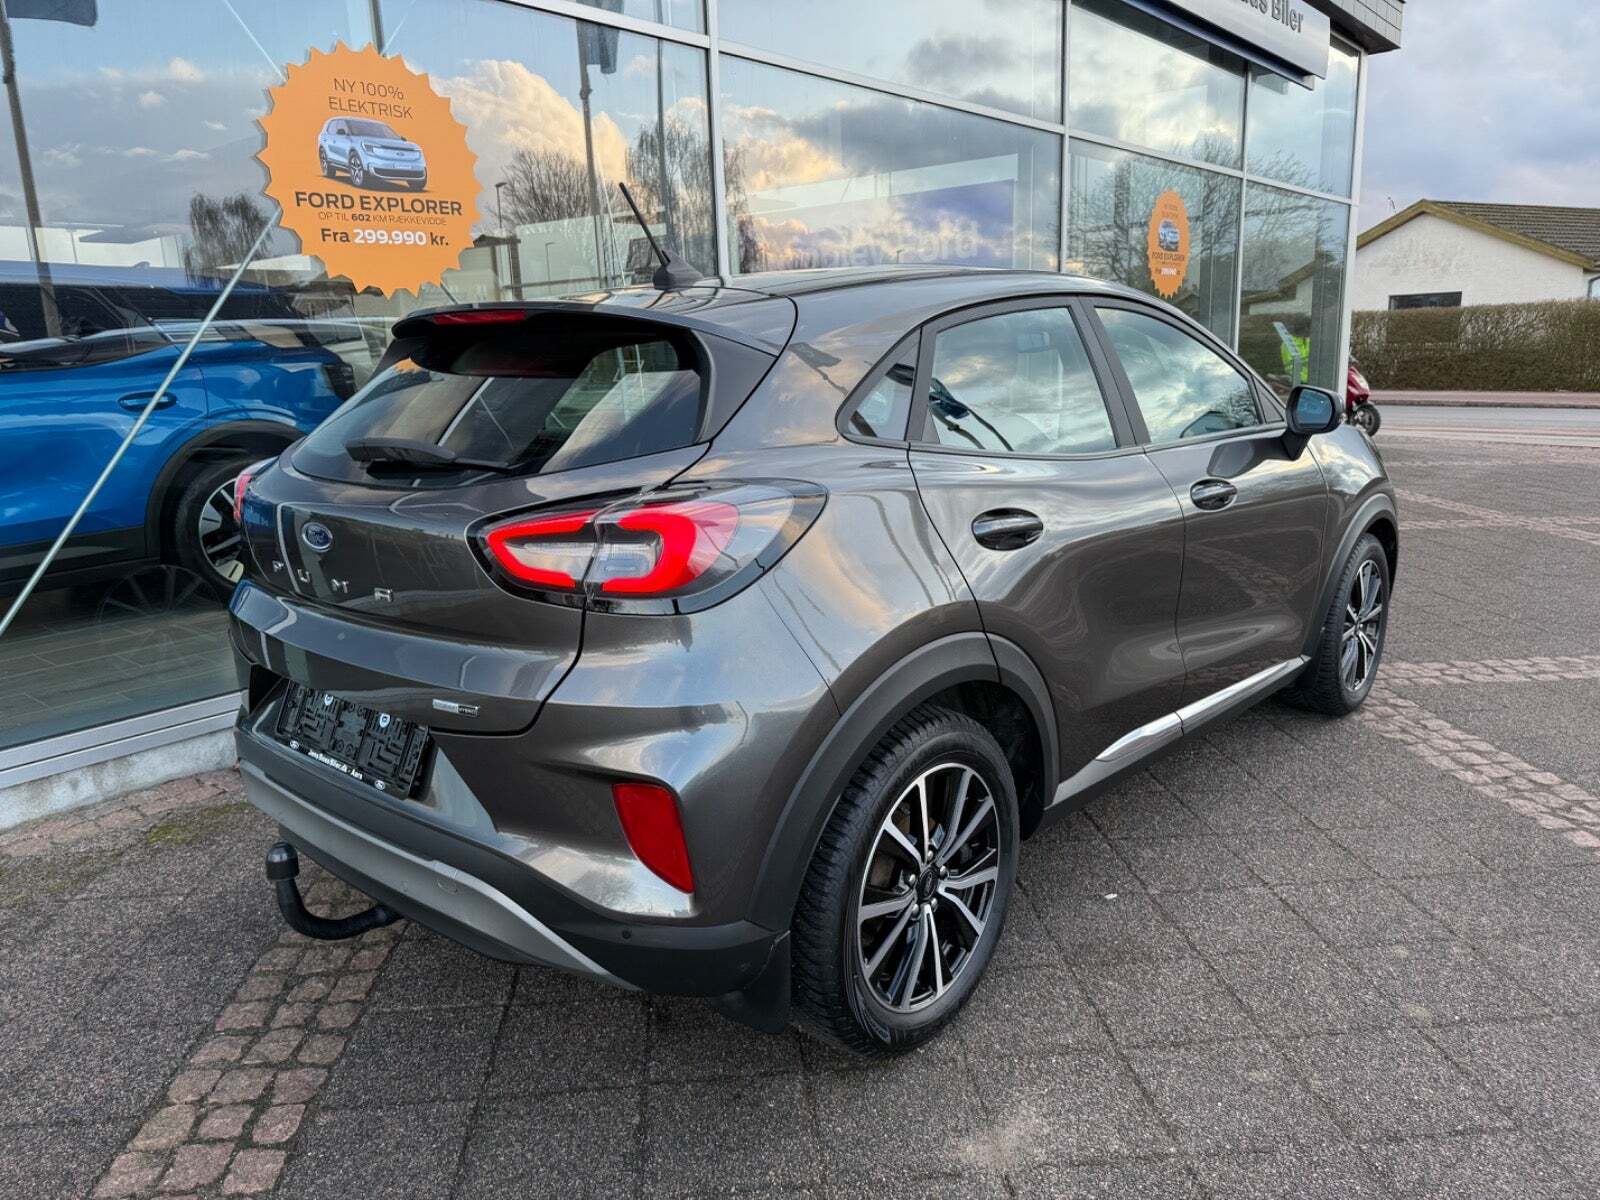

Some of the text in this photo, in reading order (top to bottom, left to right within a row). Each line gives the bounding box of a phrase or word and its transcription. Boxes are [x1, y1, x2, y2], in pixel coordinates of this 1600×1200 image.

[333, 78, 404, 100] NY 100%
[328, 96, 413, 119] ELEKTRISK
[295, 191, 462, 216] FORD EXPLORER
[318, 212, 333, 221] OP
[335, 213, 349, 222] TIL
[351, 214, 371, 222] 602
[373, 215, 388, 223] KM
[321, 228, 449, 246] Fra 299.990 kr.
